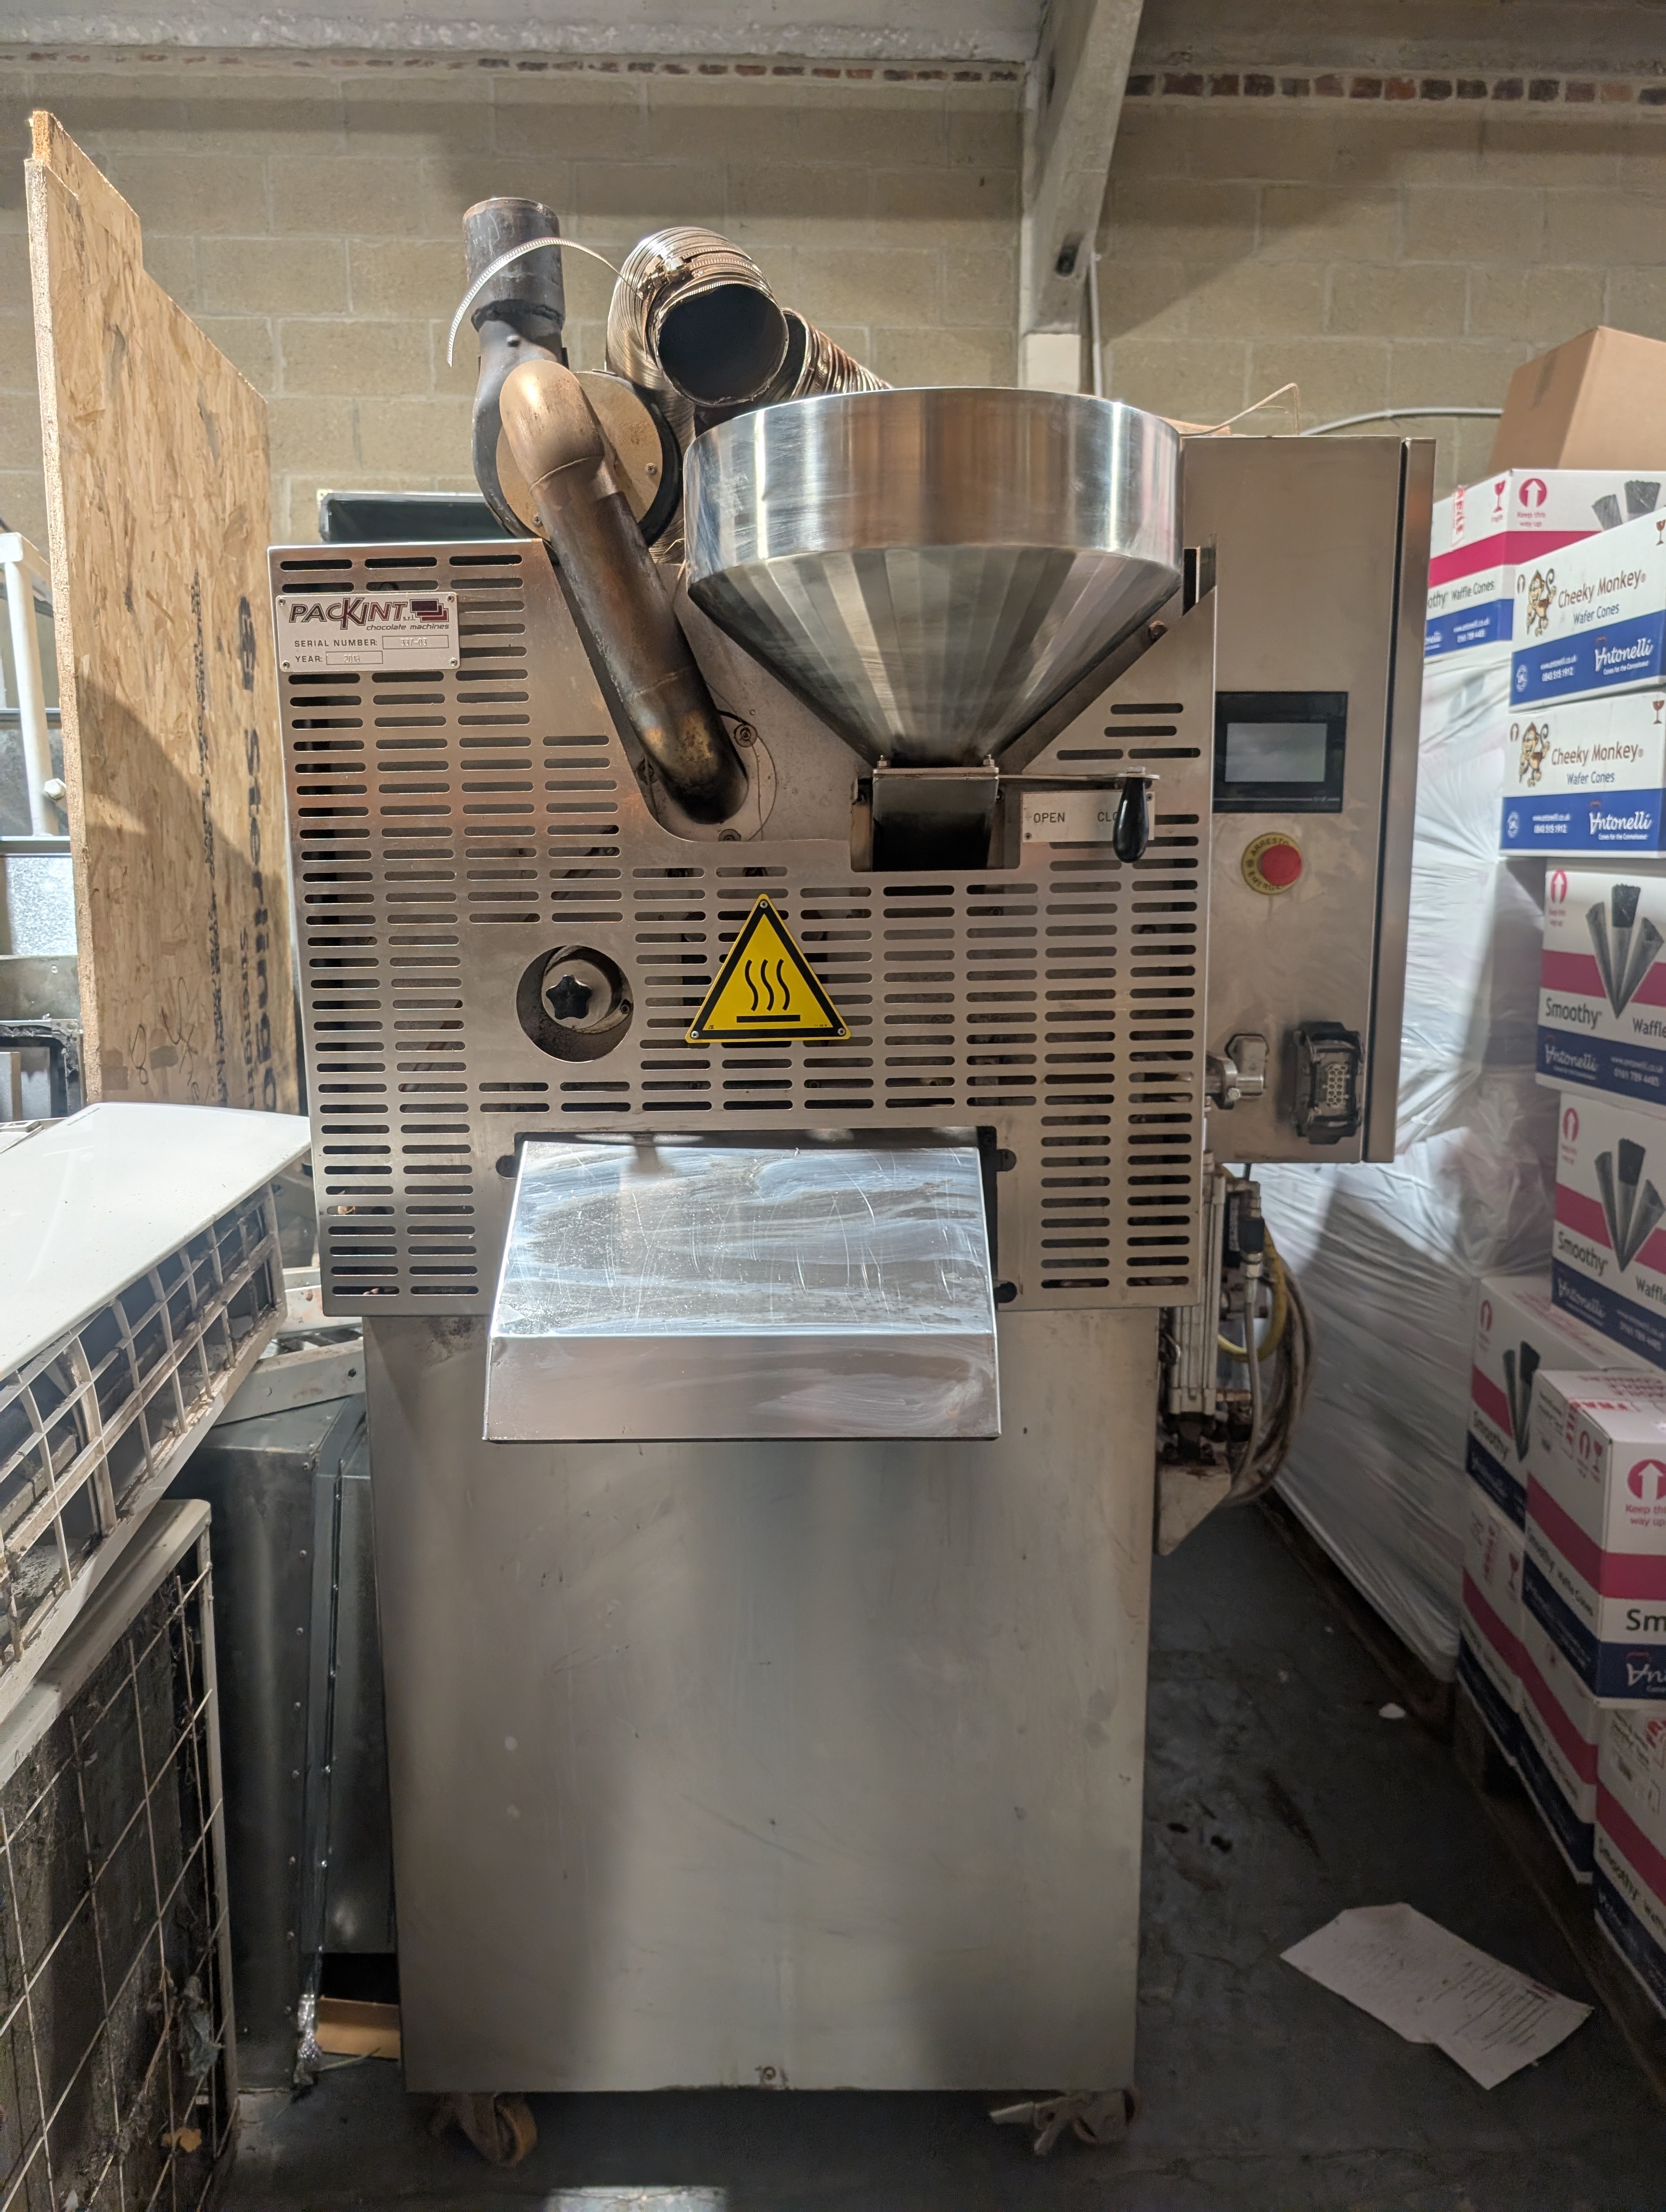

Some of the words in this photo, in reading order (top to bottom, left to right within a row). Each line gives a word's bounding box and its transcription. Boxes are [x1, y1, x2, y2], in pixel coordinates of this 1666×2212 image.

[1451, 585, 1471, 600] Waffle
[1473, 581, 1495, 595] Cones
[1558, 582, 1594, 608] Cheeky
[289, 597, 408, 630] PACKINT
[1573, 609, 1595, 625] Wafer
[1596, 603, 1620, 619] Cones
[294, 639, 329, 648] SERIAL
[334, 638, 377, 647] NUMBER:
[1594, 637, 1654, 672] Antonelli
[1551, 745, 1589, 767] Cheeky
[1566, 771, 1589, 785] Wafer
[1590, 770, 1615, 784] Cones
[1033, 812, 1065, 823] OPEN
[1589, 810, 1653, 835] Antonelli
[1546, 996, 1600, 1030] Smoothy
[1558, 1231, 1609, 1276] Smoothy
[1625, 1503, 1651, 1514] Keep
[1630, 1517, 1650, 1526] way
